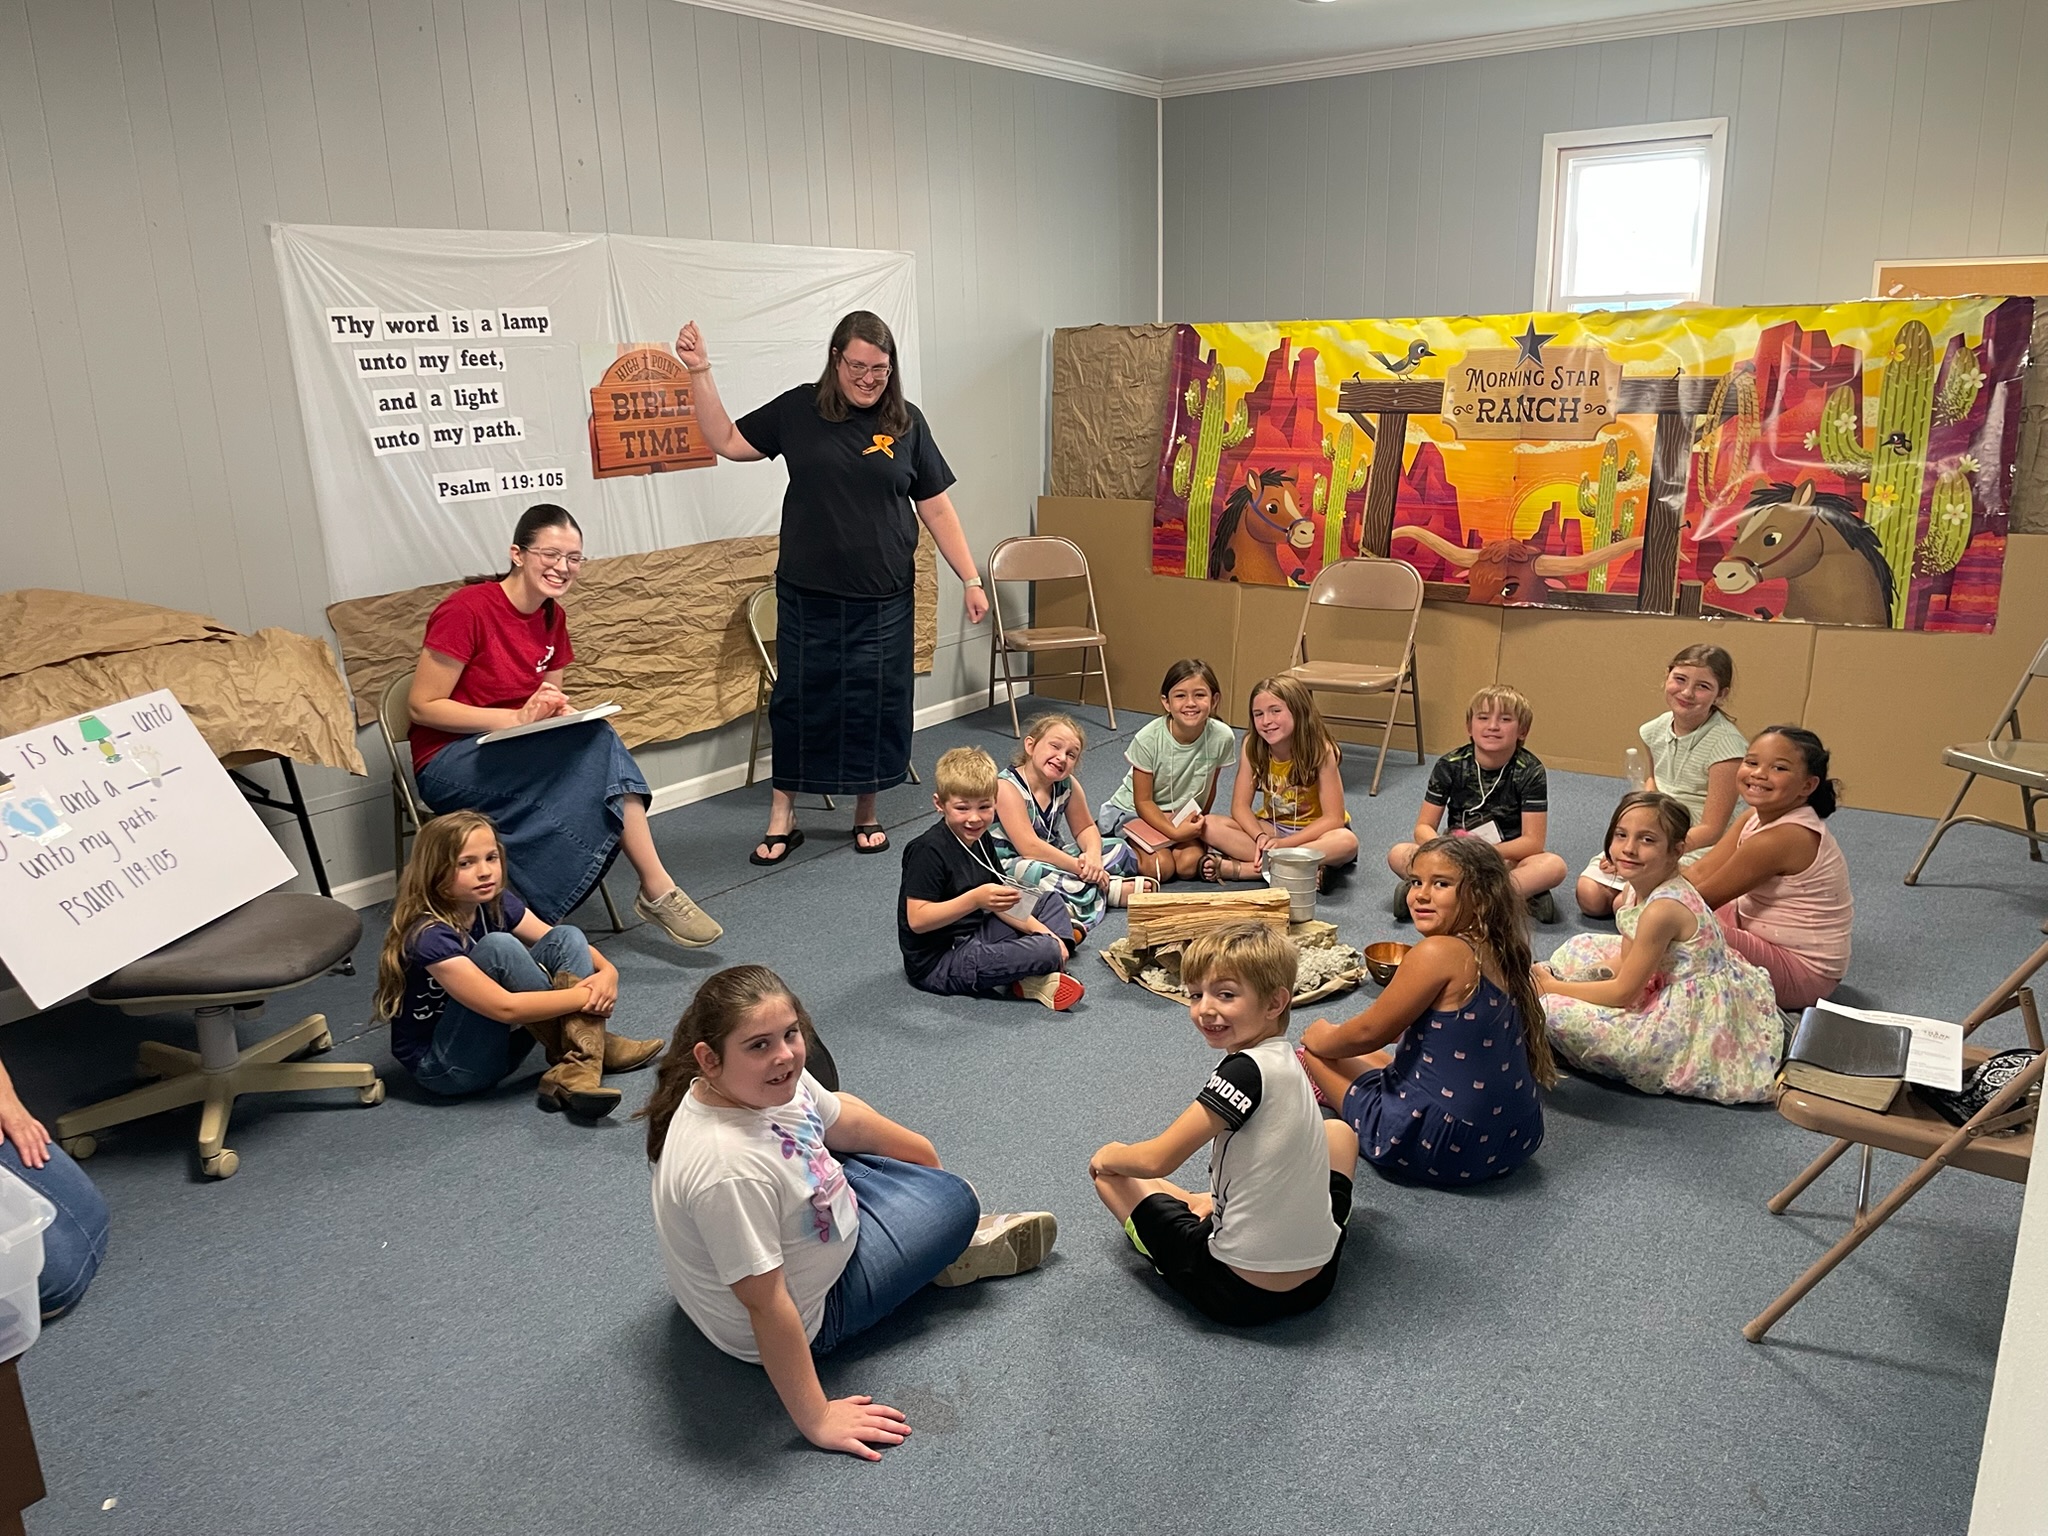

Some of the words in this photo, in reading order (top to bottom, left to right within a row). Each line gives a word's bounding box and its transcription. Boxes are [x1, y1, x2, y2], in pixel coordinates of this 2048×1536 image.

[331, 316, 374, 338] Thy
[386, 315, 439, 333] word
[452, 316, 469, 333] is
[481, 319, 492, 331] a
[502, 313, 549, 333] lamp
[359, 353, 407, 370] unto
[419, 354, 450, 372] my
[461, 350, 503, 369] feet,
[615, 357, 640, 381] HIGH
[651, 354, 681, 378] POINT
[1465, 368, 1544, 393] MORNING
[1550, 366, 1600, 390] STAR
[379, 392, 417, 411] and
[430, 393, 442, 406] a
[454, 388, 499, 410] light
[611, 389, 691, 421] BIBLE
[1475, 395, 1581, 423] RANCH
[374, 431, 420, 449] unto
[434, 427, 464, 445] my
[473, 421, 521, 443] path.
[620, 427, 690, 459] TIME
[438, 479, 491, 497] Psalm
[501, 472, 563, 490] 119:105
[16, 743, 46, 769] is
[53, 735, 74, 756] a
[132, 703, 173, 733] unto
[60, 780, 101, 814] and
[104, 780, 121, 797] a
[19, 845, 75, 879] unto
[79, 830, 121, 863] my
[121, 848, 177, 888] 119:105
